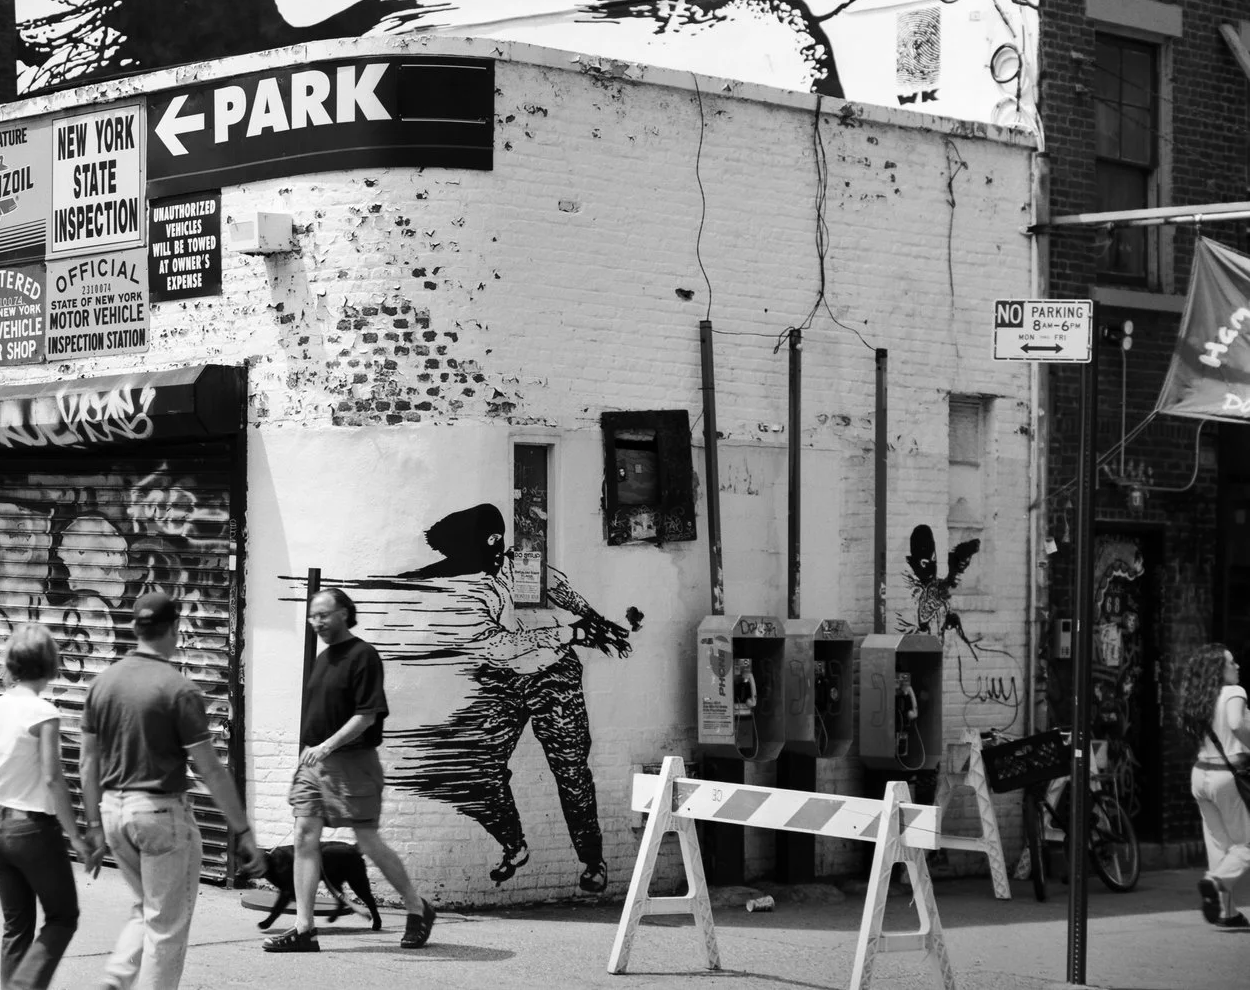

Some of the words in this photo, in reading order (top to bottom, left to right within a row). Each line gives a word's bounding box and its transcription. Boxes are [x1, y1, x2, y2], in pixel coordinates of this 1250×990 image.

[213, 62, 393, 144] PARK
[58, 122, 88, 161] NEW
[95, 115, 136, 154] YORK
[73, 159, 117, 199] STATE
[54, 197, 138, 243] INSPECTION
[153, 200, 216, 222] UNAUTHORIZED
[166, 219, 202, 238] VEHICLES
[152, 241, 172, 257] WILL
[174, 239, 185, 254] BE
[187, 235, 216, 253] TOWED
[159, 259, 170, 274] AT
[172, 254, 210, 272] OWNER'S
[56, 259, 139, 293] OFFICIAL
[166, 272, 203, 290] EXPENSE
[81, 283, 111, 295] 2310074
[18, 304, 42, 315] YORK
[51, 300, 77, 310] STATE
[80, 297, 92, 307] OF
[95, 294, 114, 305] NEW
[118, 291, 143, 302] YORK
[50, 309, 90, 330] MOTOR
[93, 303, 144, 326] VEHICLE
[997, 303, 1022, 324] NO
[1031, 307, 1084, 318] PARKING
[6, 340, 37, 359] SHOP
[48, 332, 104, 354] INSPECTION
[106, 328, 146, 350] STATION
